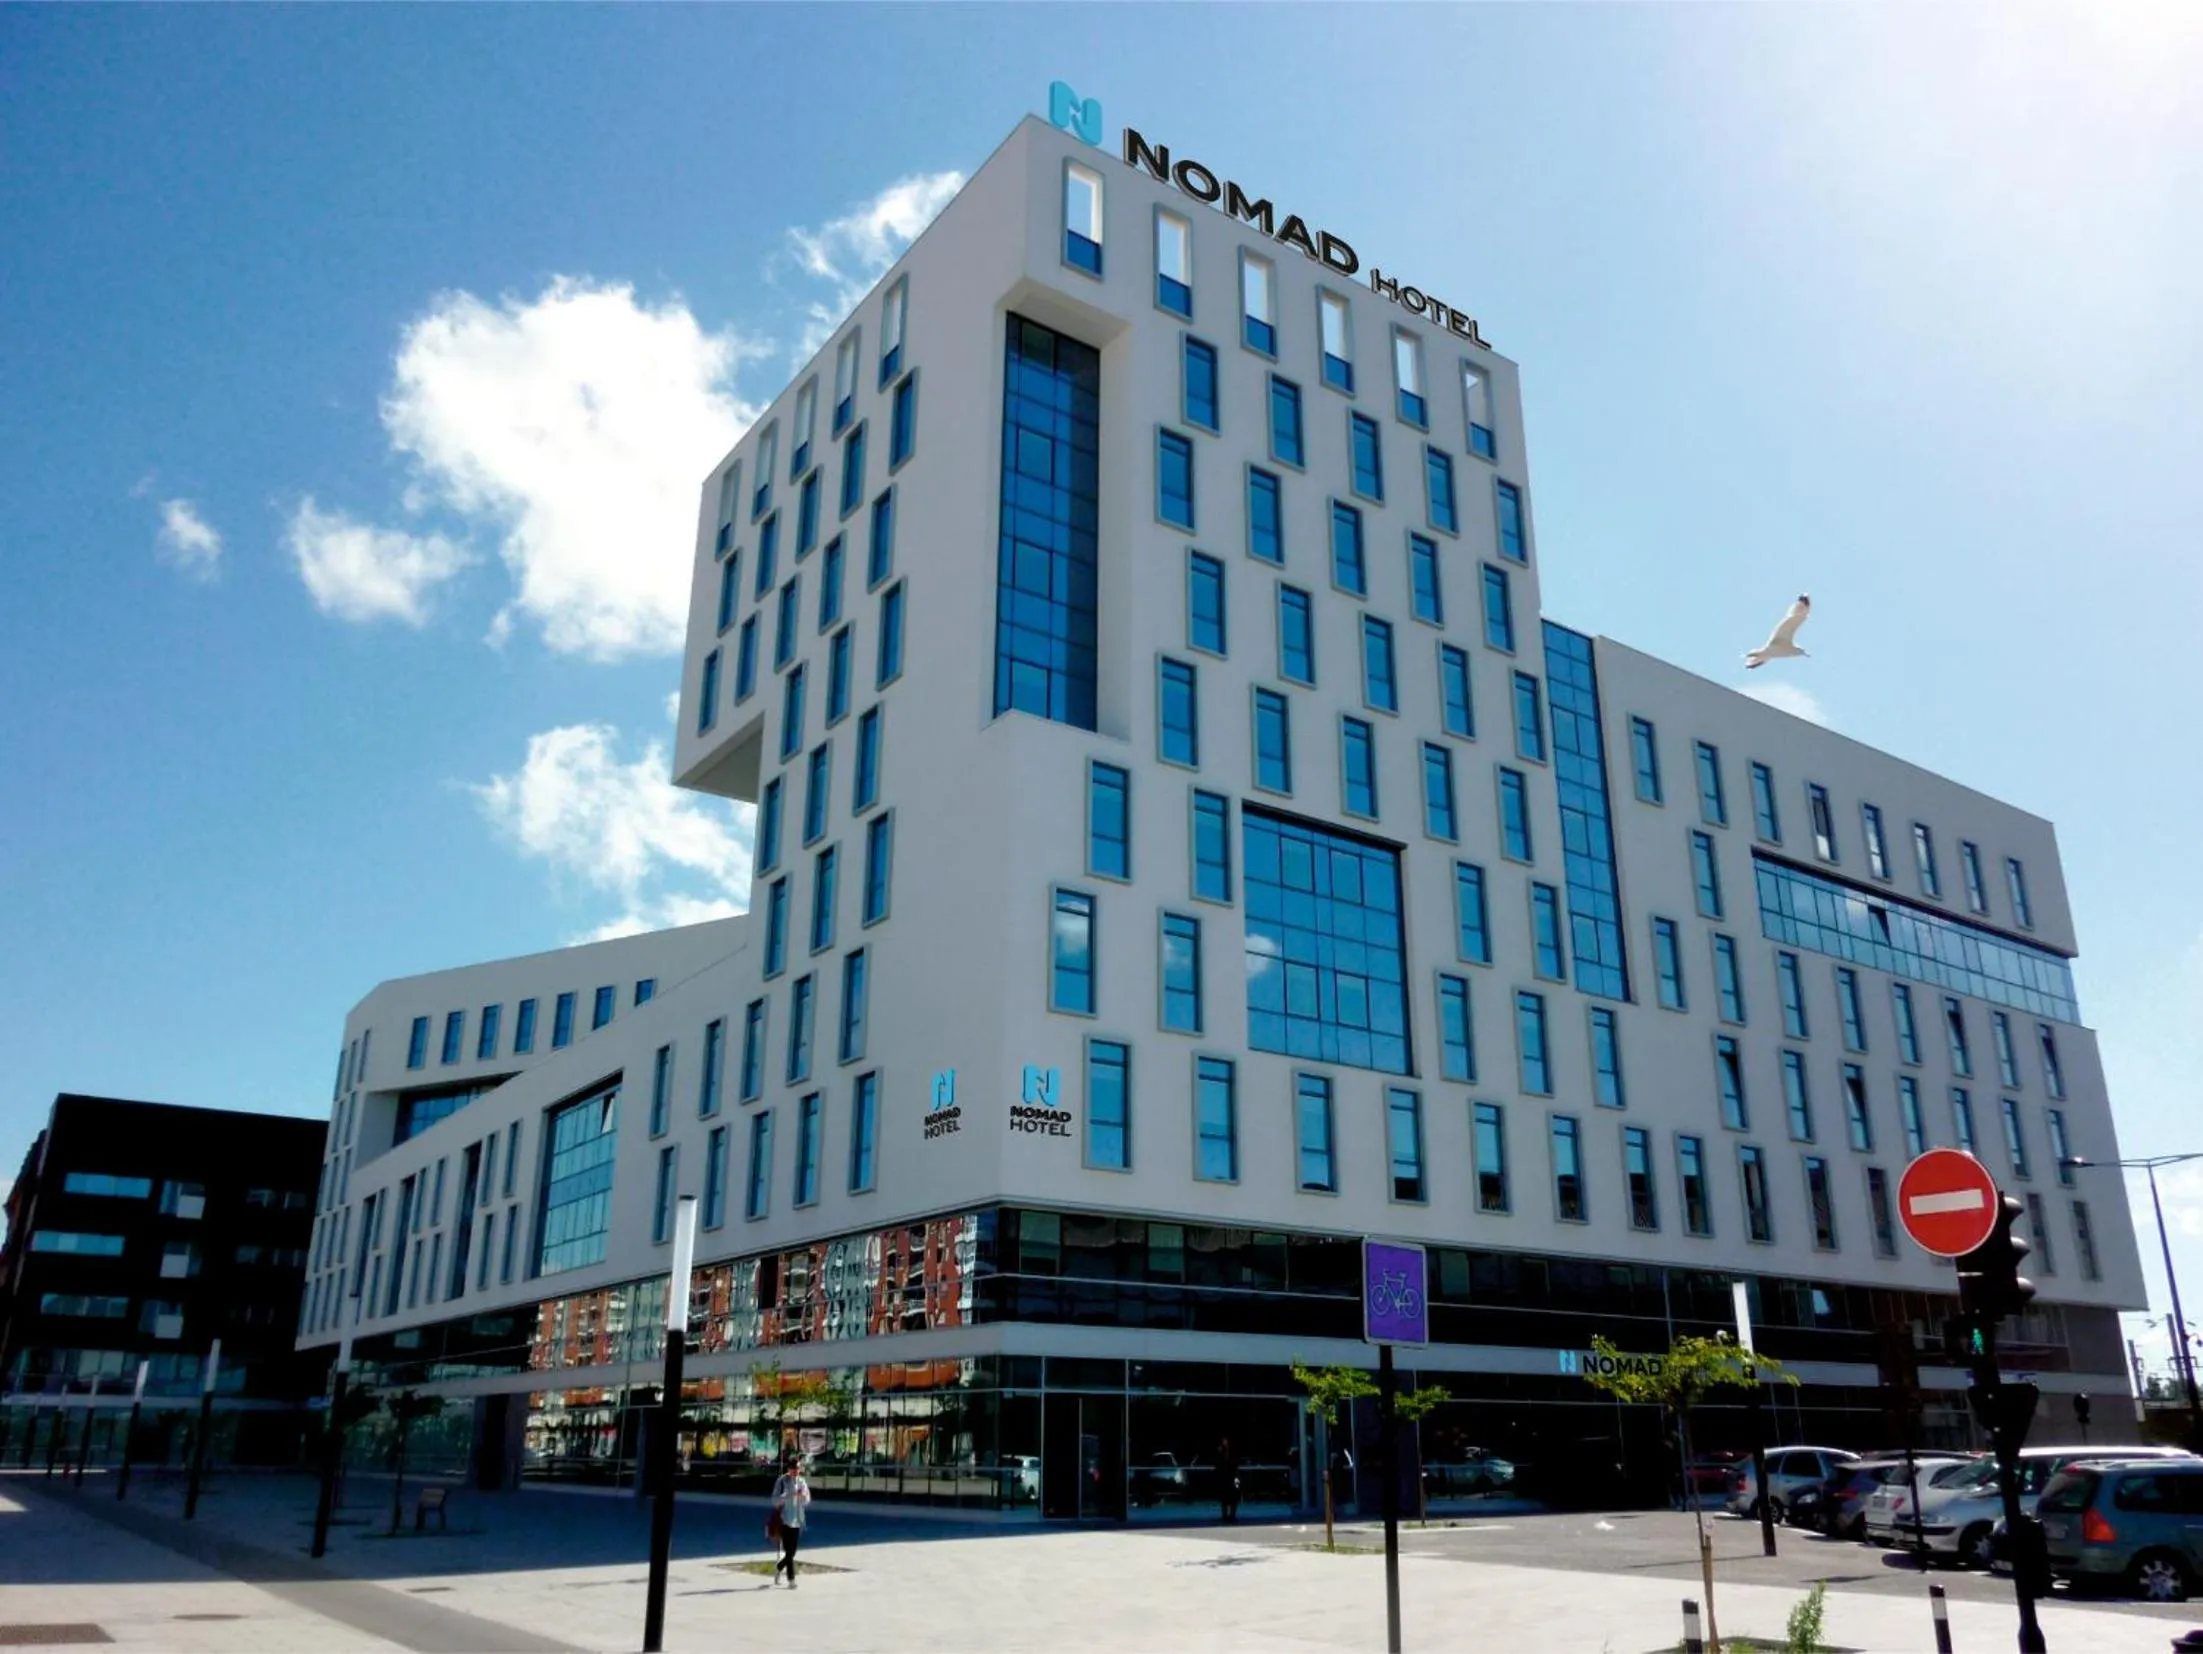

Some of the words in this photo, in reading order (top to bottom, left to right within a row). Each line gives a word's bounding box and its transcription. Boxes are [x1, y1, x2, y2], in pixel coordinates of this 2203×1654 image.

[1123, 127, 1359, 276] NOMAD
[1370, 268, 1491, 350] HOTEL
[925, 1107, 961, 1126] NOMAD
[1009, 1105, 1072, 1122] NOMAD
[924, 1121, 961, 1139] HOTEL
[1009, 1119, 1072, 1136] HOTEL
[1583, 1356, 1662, 1376] NOMAD
